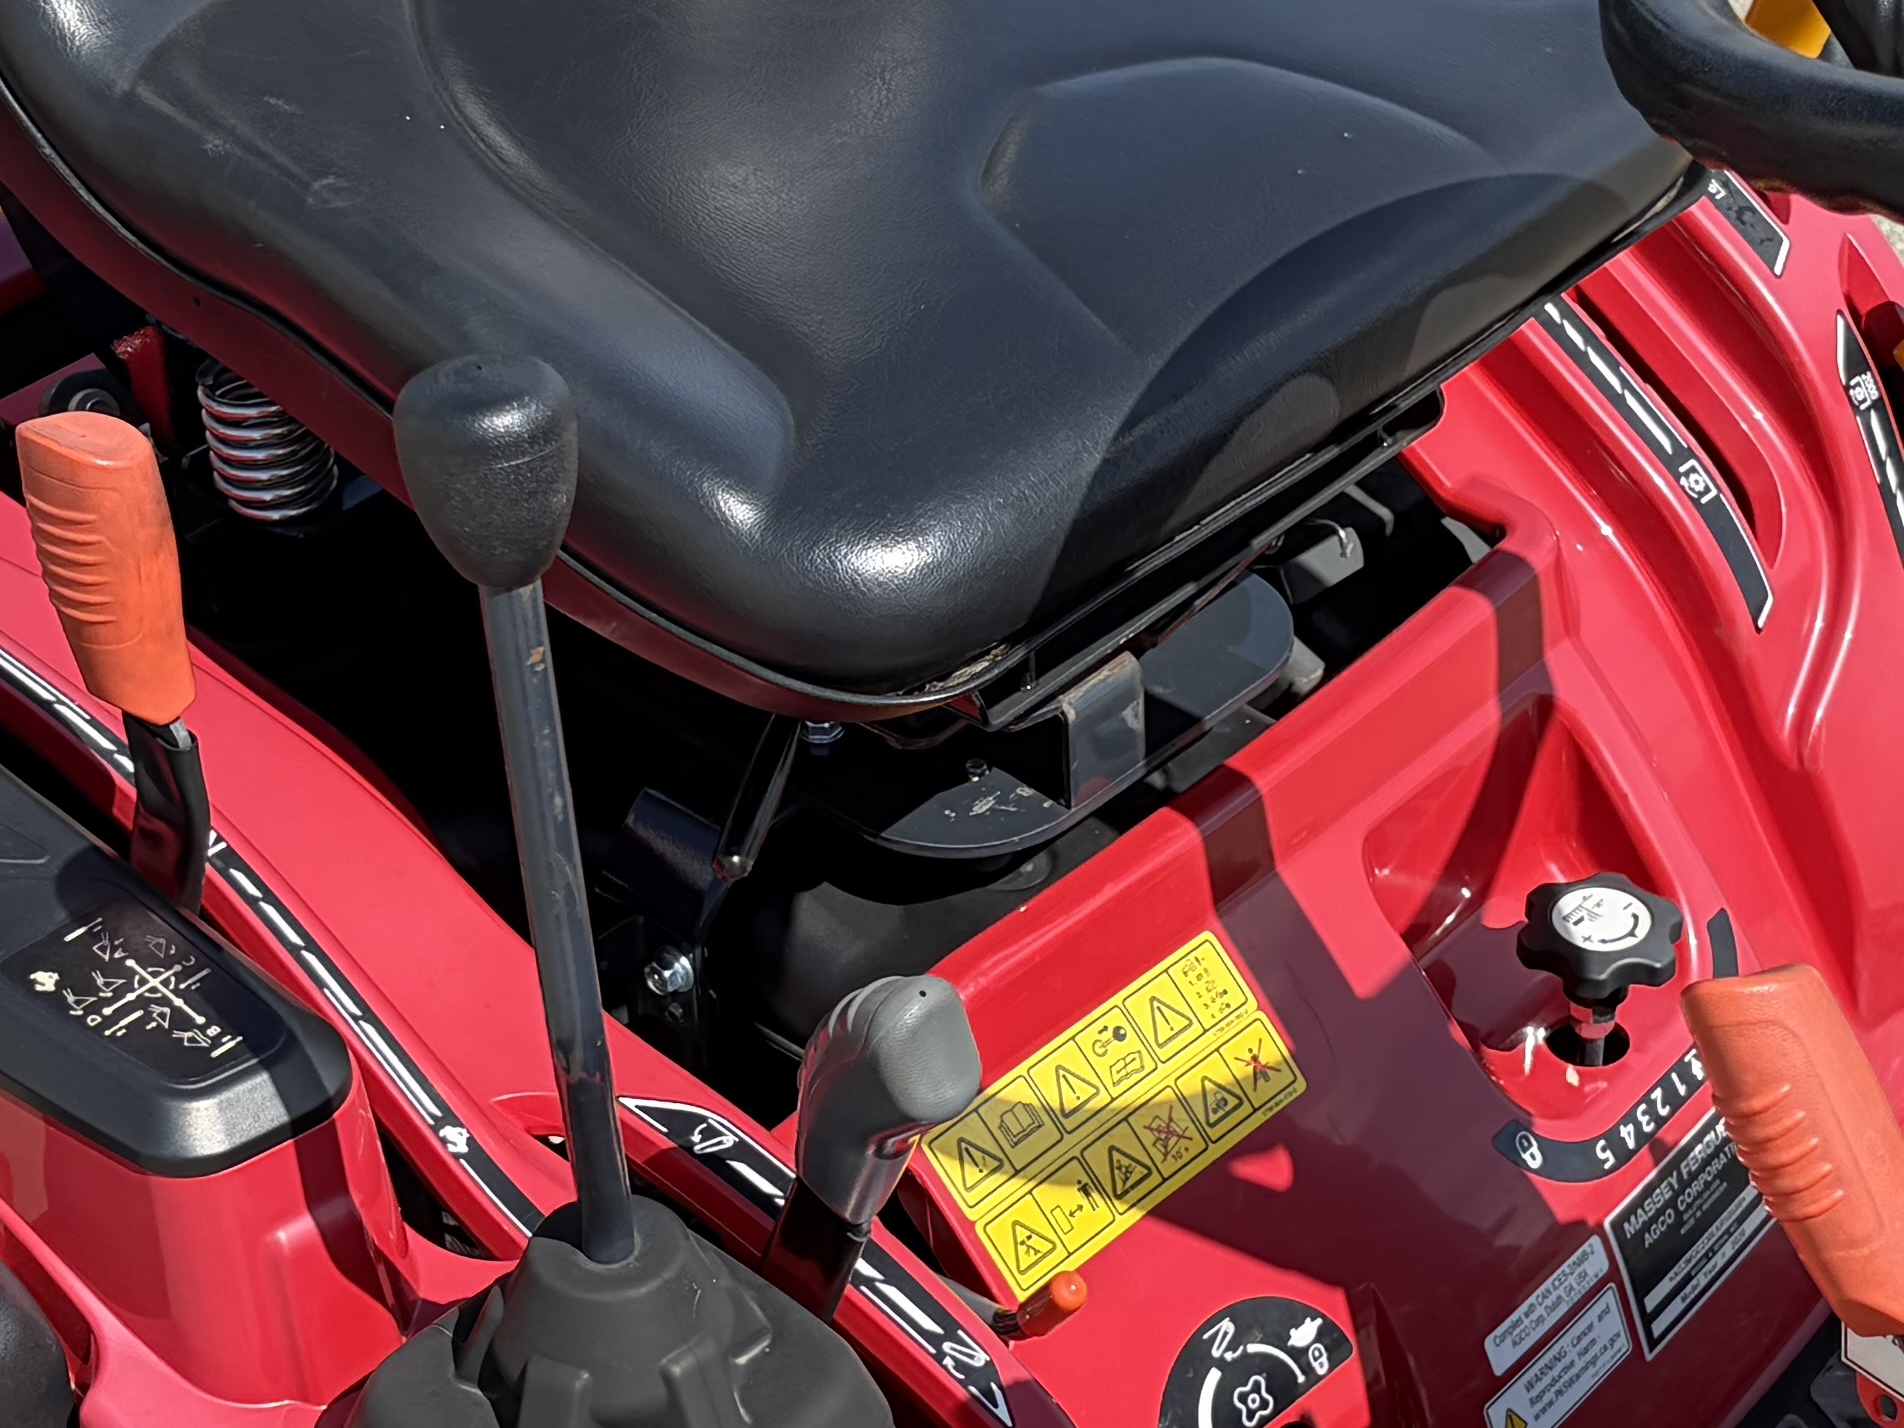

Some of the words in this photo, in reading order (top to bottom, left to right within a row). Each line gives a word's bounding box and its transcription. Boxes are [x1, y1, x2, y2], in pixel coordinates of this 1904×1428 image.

[87, 1015, 102, 1026] D
[207, 1025, 221, 1037] B
[1671, 1072, 1686, 1096] 1
[1650, 1087, 1670, 1117] 2
[1636, 1103, 1655, 1132] 3
[1620, 1123, 1635, 1149] 4
[1596, 1139, 1616, 1169] 5
[1622, 1169, 1682, 1240] MASSEY
[1641, 1204, 1676, 1249] AGCO
